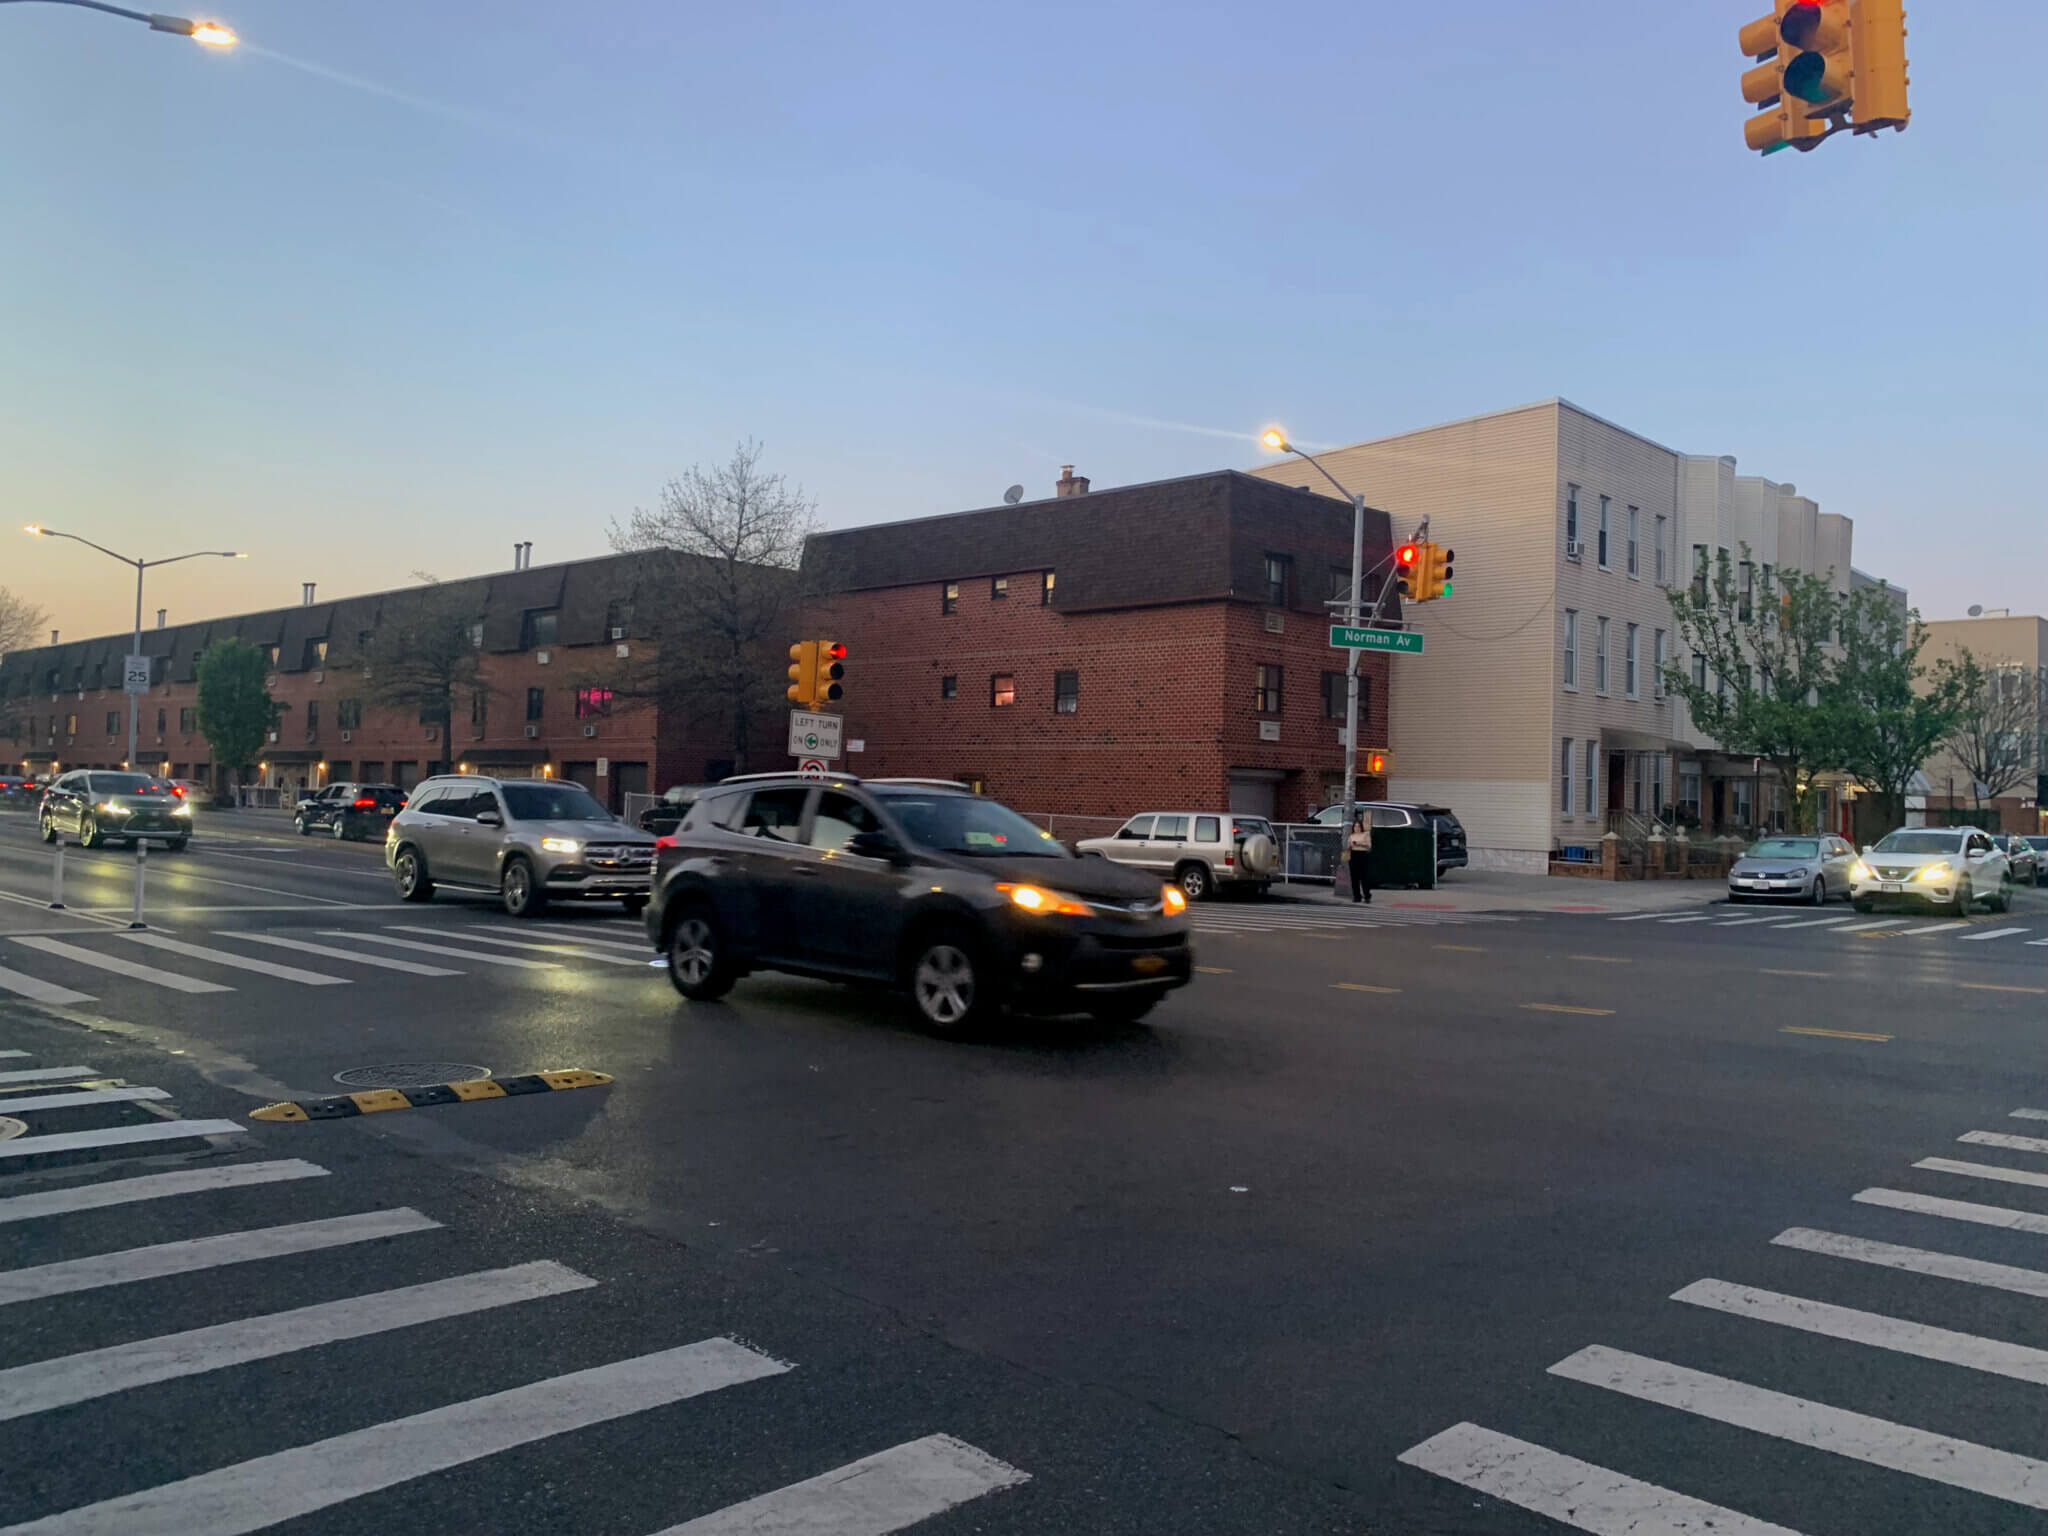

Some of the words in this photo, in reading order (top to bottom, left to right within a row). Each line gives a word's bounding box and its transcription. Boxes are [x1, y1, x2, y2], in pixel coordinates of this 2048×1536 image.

[1345, 630, 1390, 644] Norman
[1396, 635, 1411, 646] Av
[128, 671, 147, 682] 25
[795, 717, 814, 728] LEFT
[818, 719, 839, 729] TURN
[793, 735, 803, 745] ON
[820, 739, 837, 748] ONLY
